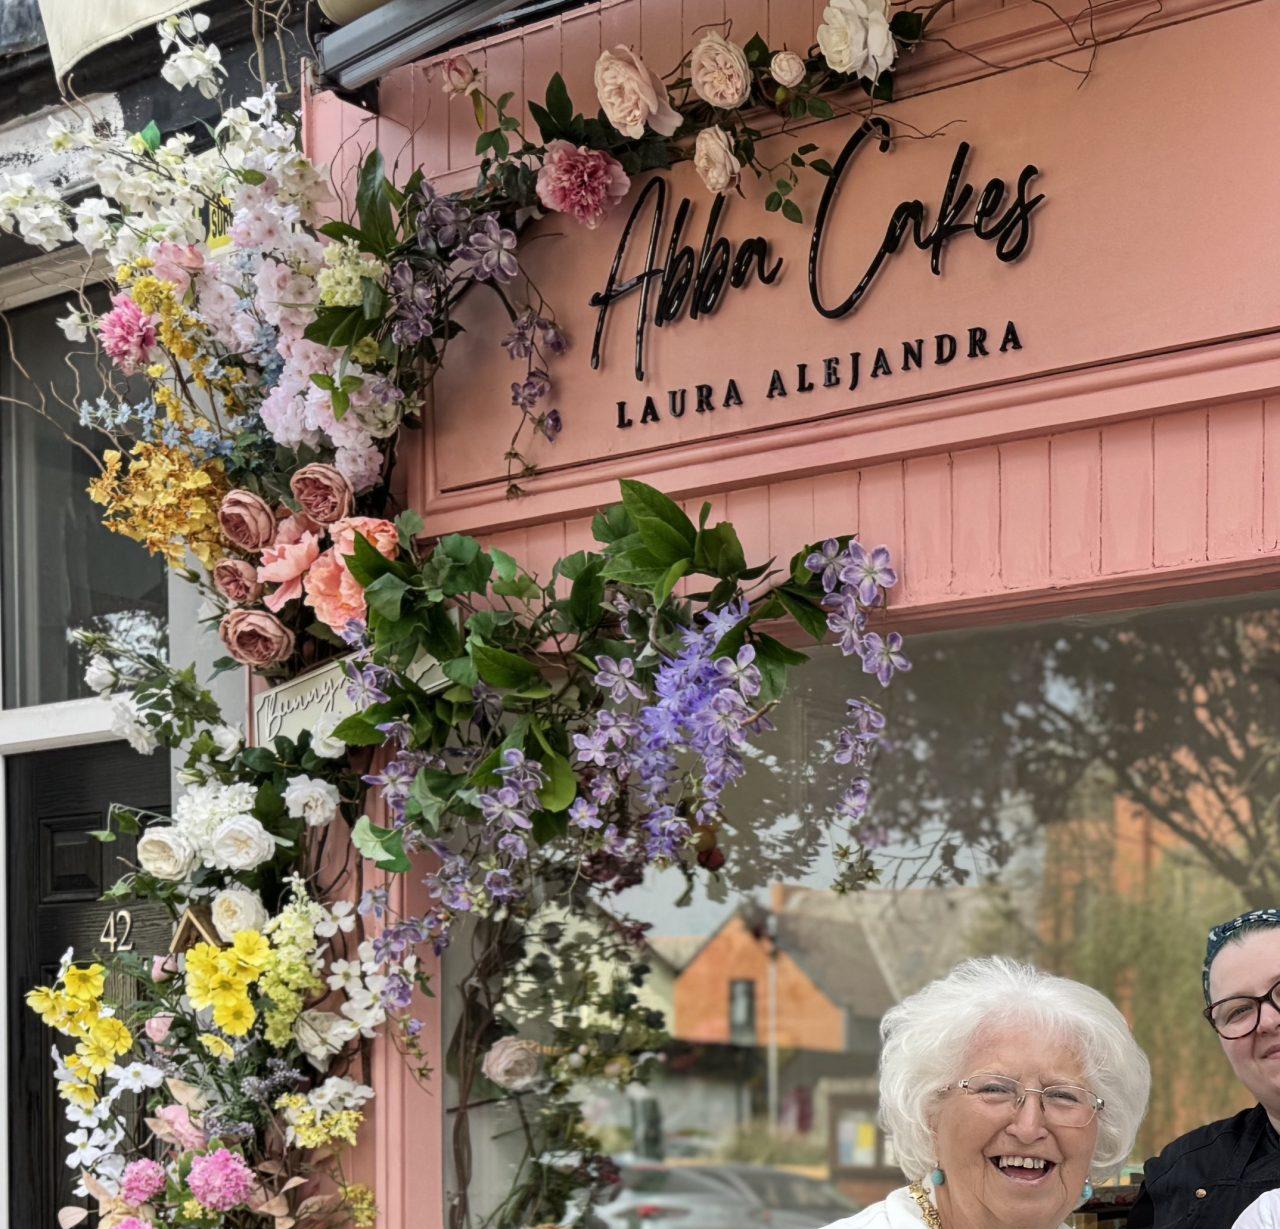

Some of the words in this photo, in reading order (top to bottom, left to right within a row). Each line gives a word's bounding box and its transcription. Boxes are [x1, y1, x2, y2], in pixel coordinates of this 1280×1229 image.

[588, 175, 783, 382] Abba
[809, 116, 1046, 319] Cakes
[616, 378, 743, 429] LAURA
[766, 320, 1023, 400] ALEJANDRA
[99, 910, 133, 953] 42
